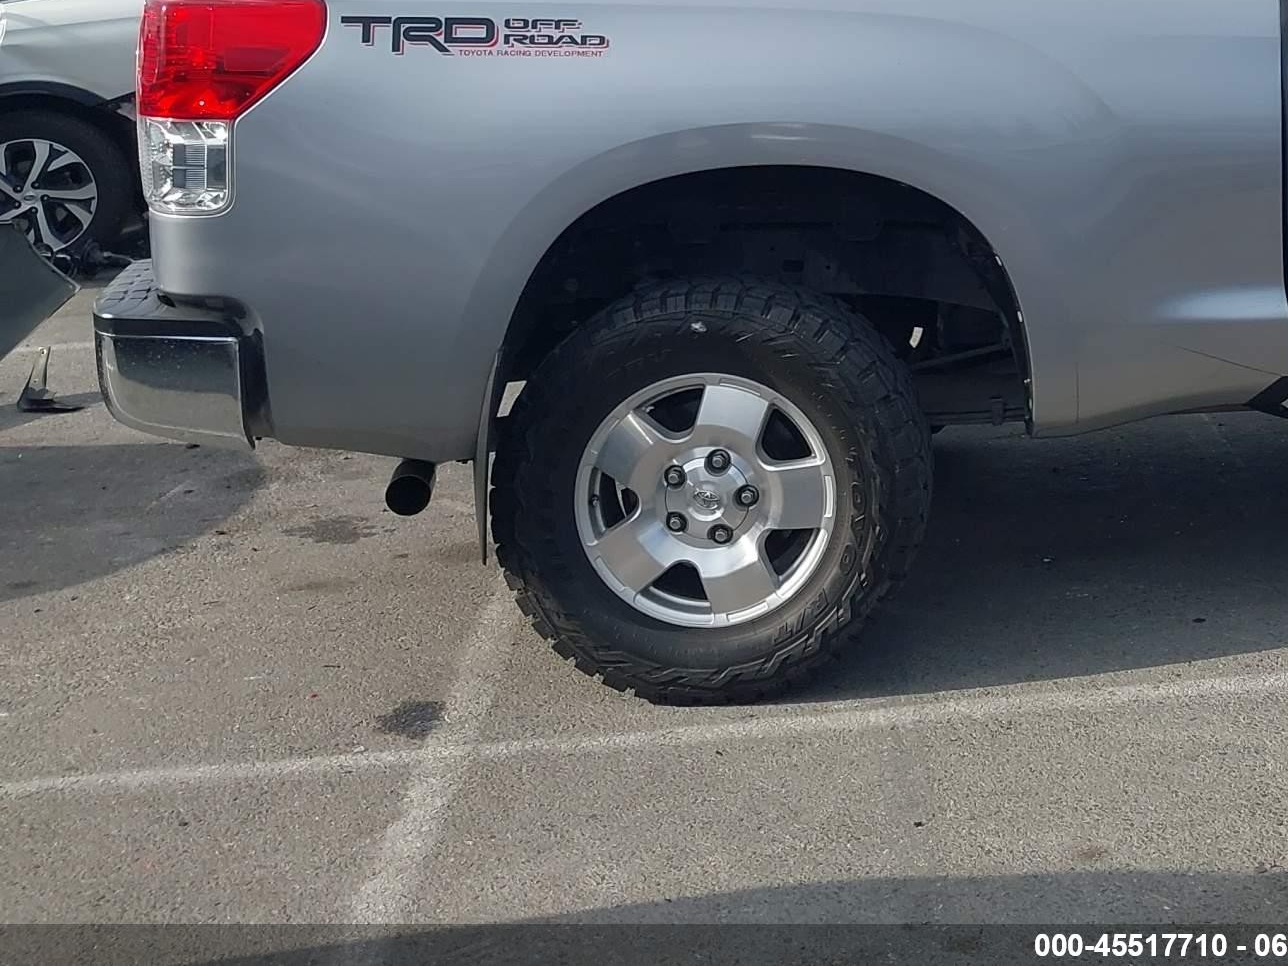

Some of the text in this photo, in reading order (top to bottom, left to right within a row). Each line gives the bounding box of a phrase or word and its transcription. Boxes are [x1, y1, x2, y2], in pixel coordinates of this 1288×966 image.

[341, 16, 498, 55] TRD
[504, 33, 609, 48] ROAD
[459, 49, 604, 57] TOYOTA RACING DEVELOPMENT
